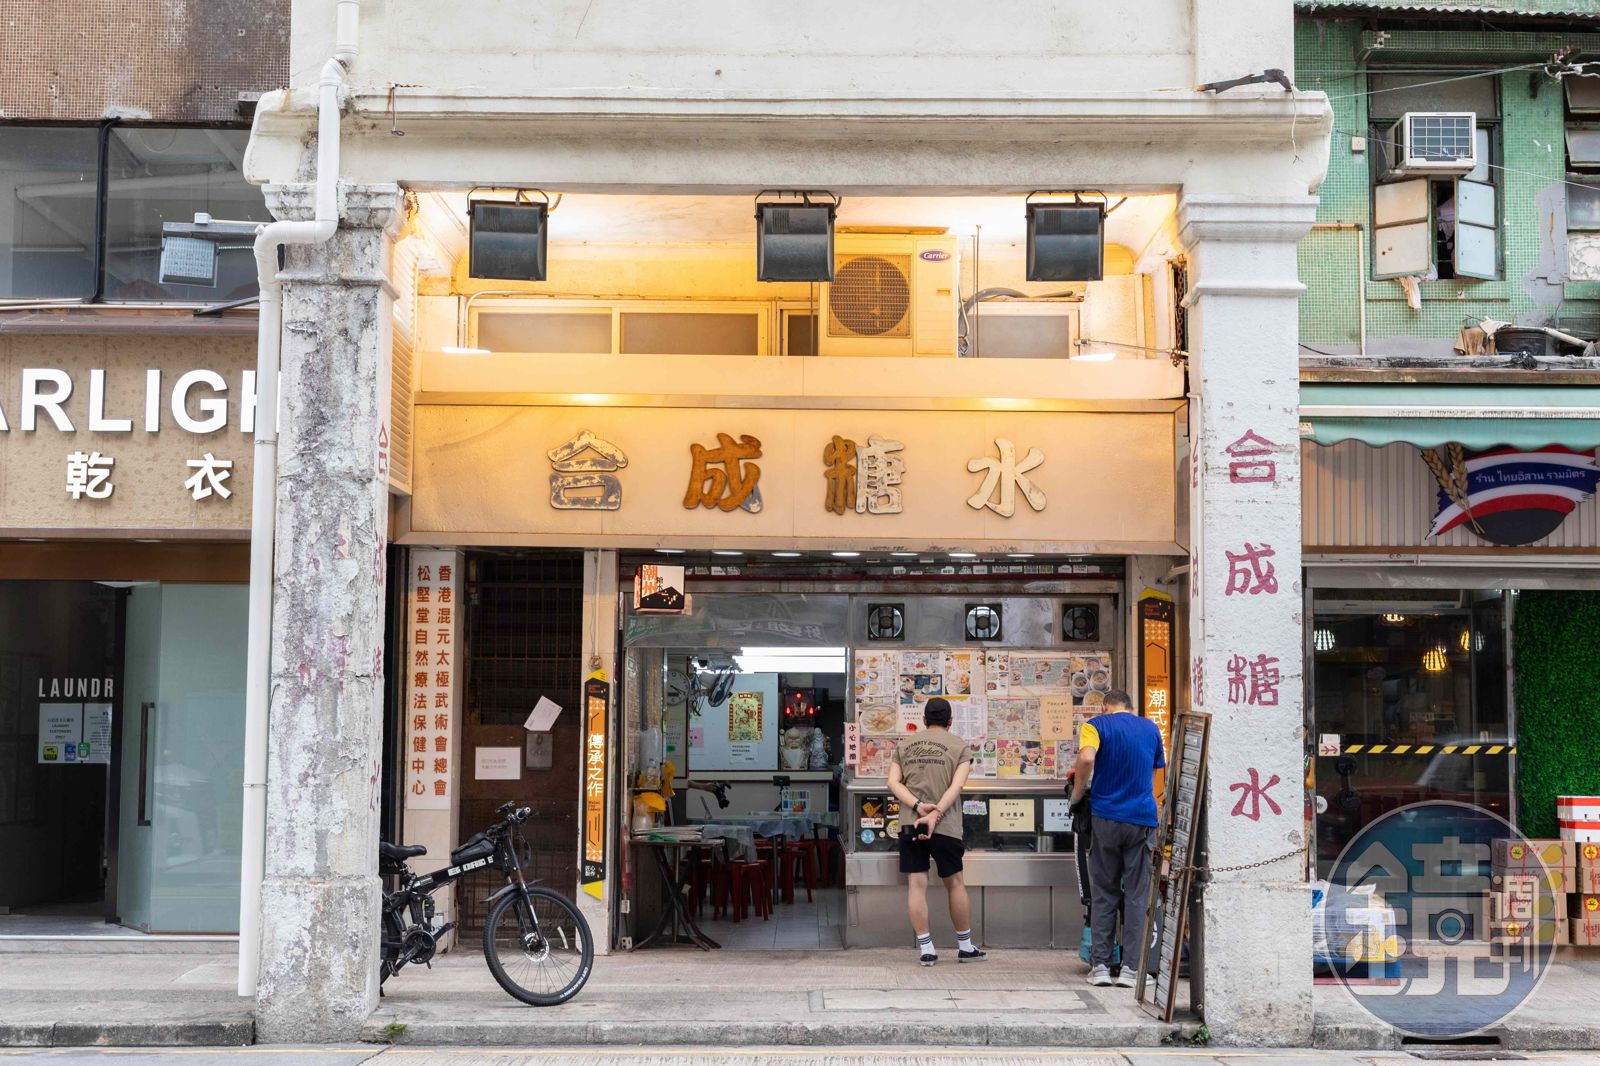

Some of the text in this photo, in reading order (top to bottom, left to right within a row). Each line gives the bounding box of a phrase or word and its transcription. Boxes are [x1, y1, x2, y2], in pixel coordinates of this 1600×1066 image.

[66, 451, 233, 500] 乾衣
[547, 428, 1047, 517] 合成糖水
[1225, 429, 1282, 822] 合成糖水
[587, 732, 605, 798] 傳承之作
